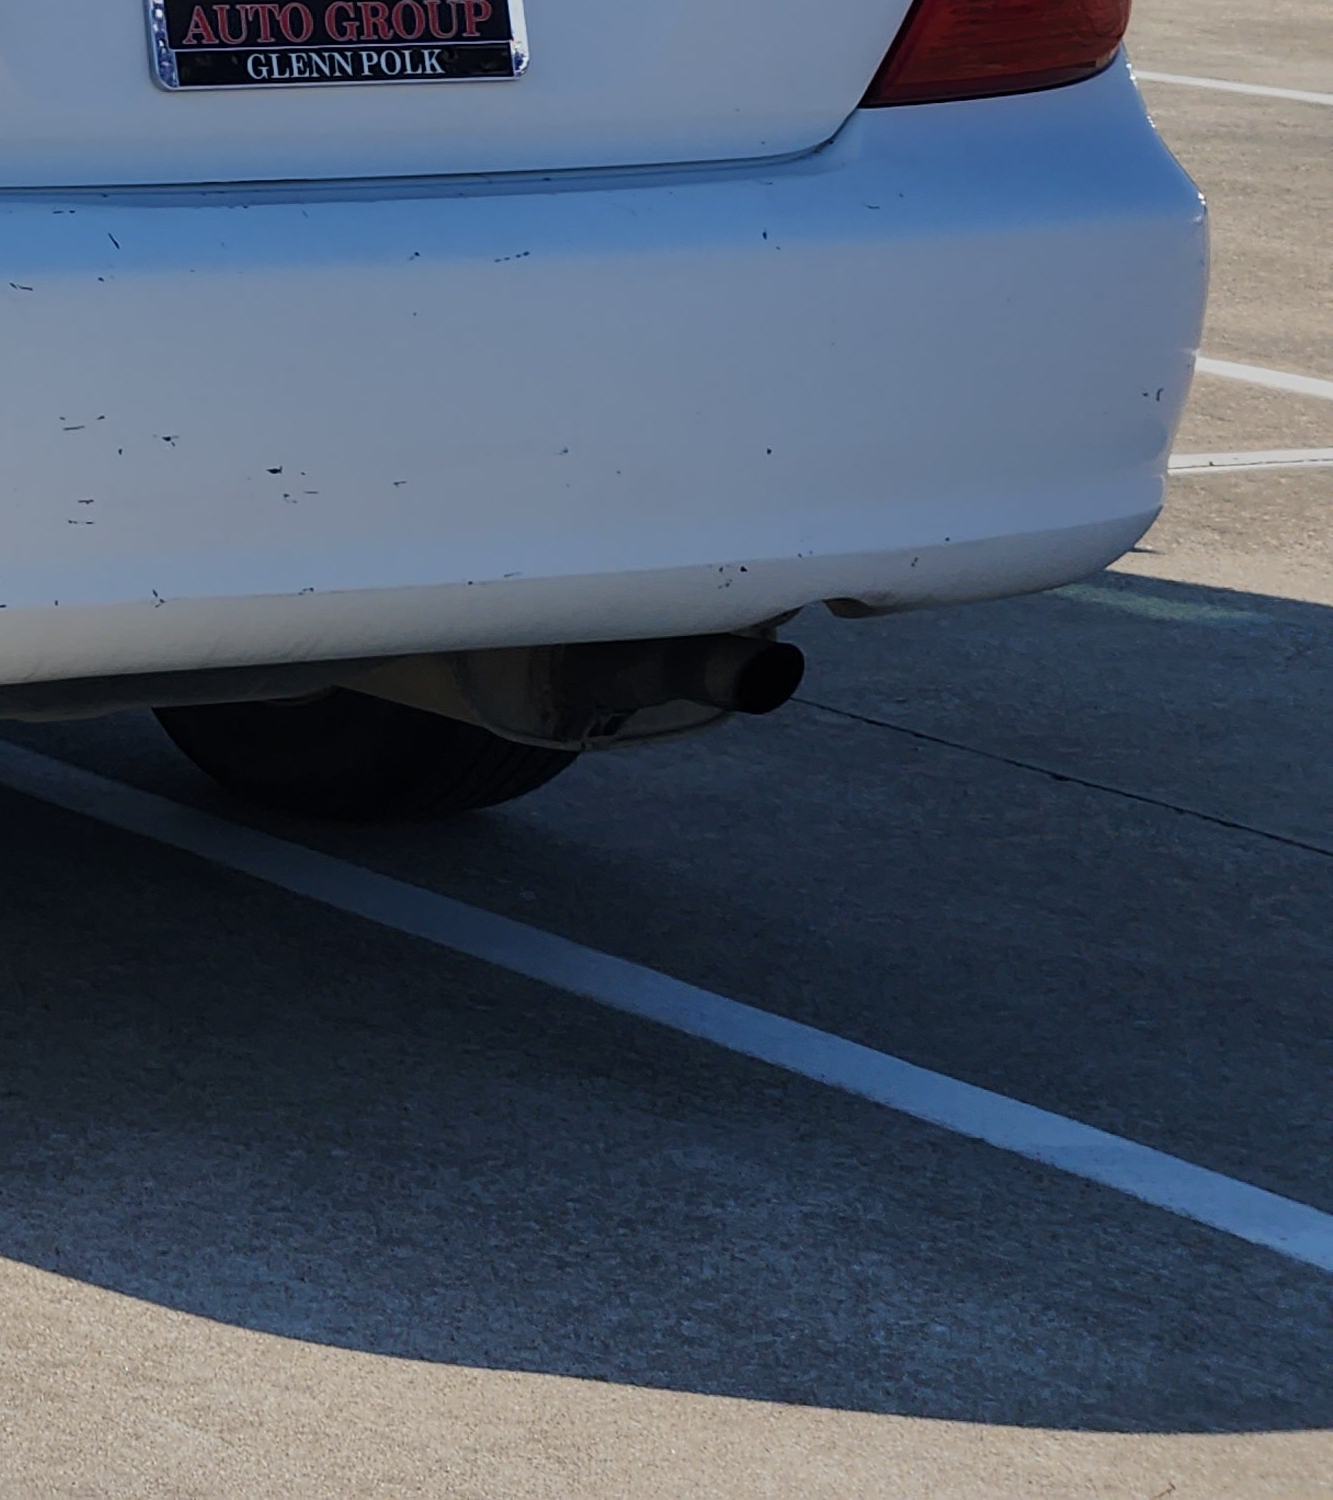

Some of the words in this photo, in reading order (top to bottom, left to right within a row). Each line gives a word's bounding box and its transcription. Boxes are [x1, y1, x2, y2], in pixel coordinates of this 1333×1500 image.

[181, 1, 314, 46] AUTO
[247, 50, 354, 80] GLENN
[361, 48, 447, 76] POLK
